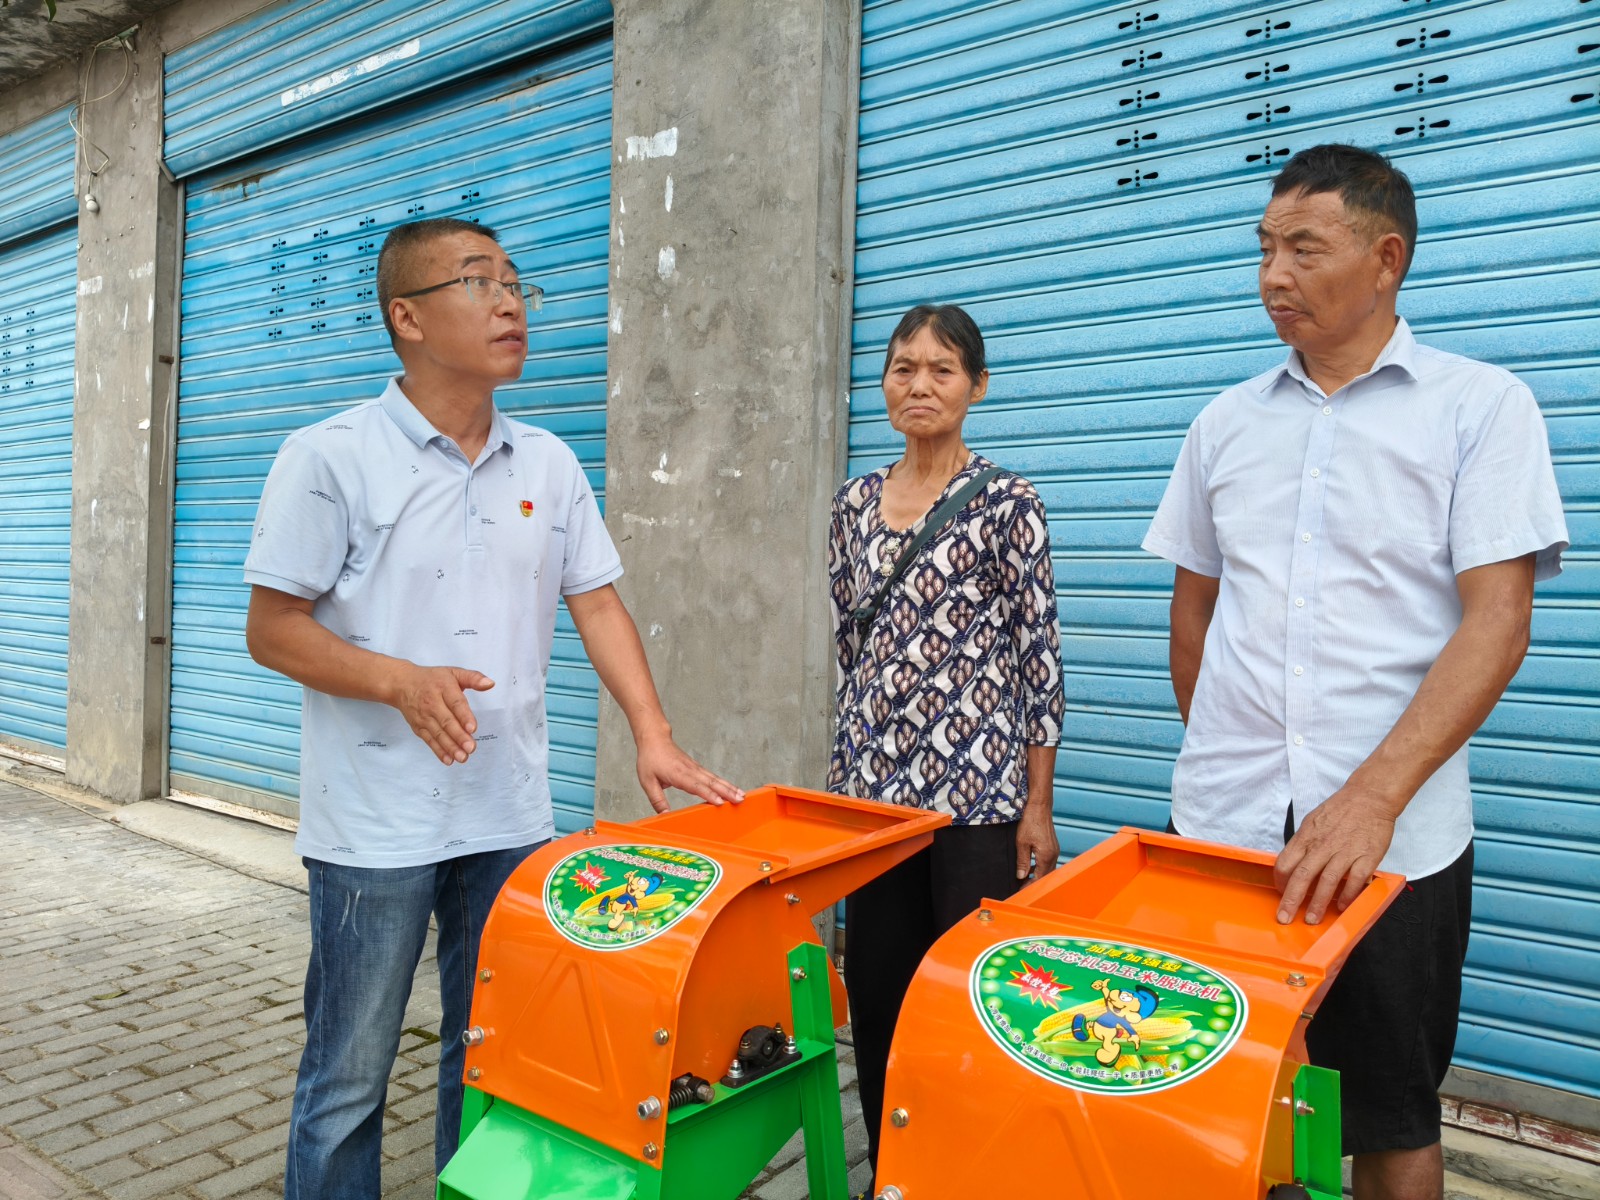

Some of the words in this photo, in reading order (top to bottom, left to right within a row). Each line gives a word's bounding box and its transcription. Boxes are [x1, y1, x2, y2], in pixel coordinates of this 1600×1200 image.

[1023, 941, 1222, 1001] 不烂芯机动玉米脱粒机
[1085, 944, 1183, 973] 加厚加强型
